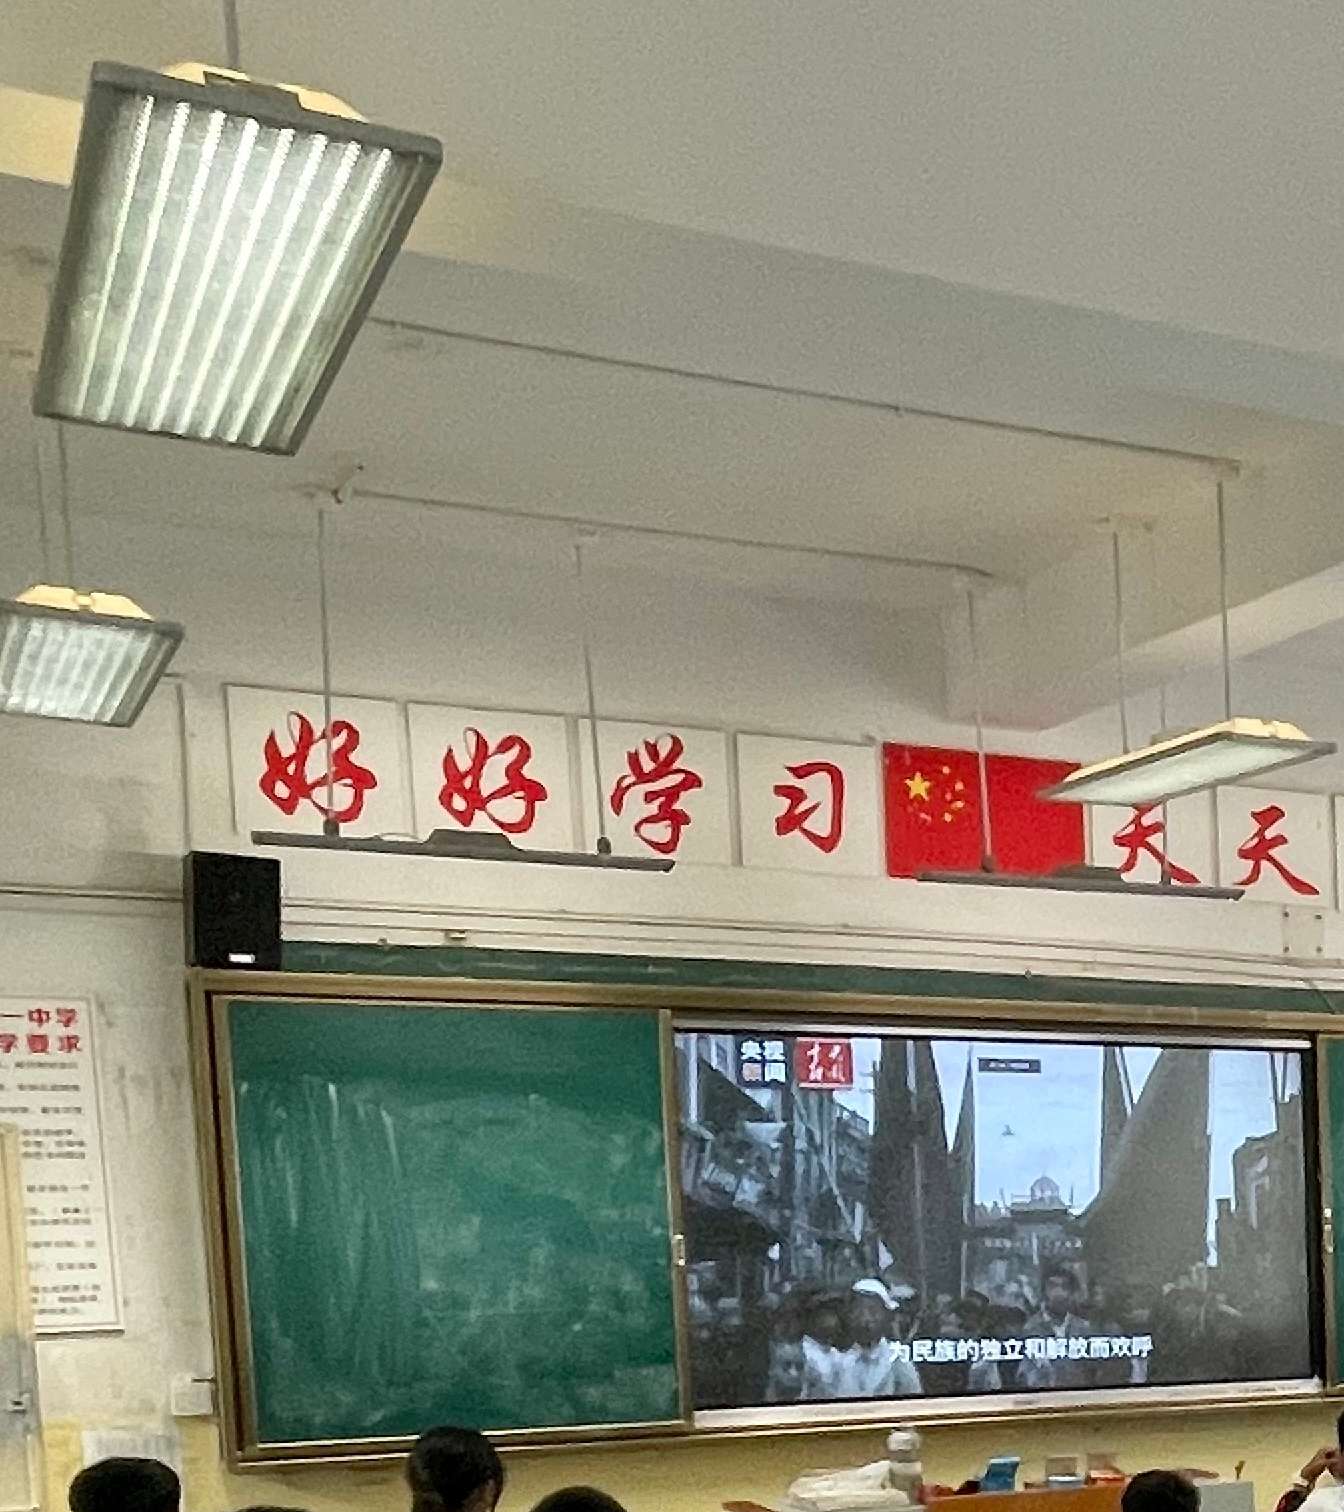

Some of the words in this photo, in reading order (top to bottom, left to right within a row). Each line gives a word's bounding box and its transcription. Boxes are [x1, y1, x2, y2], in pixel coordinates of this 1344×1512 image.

[258, 710, 845, 855] 好好学习
[889, 1335, 1152, 1362] 为民族的独立和解放而欢呼
